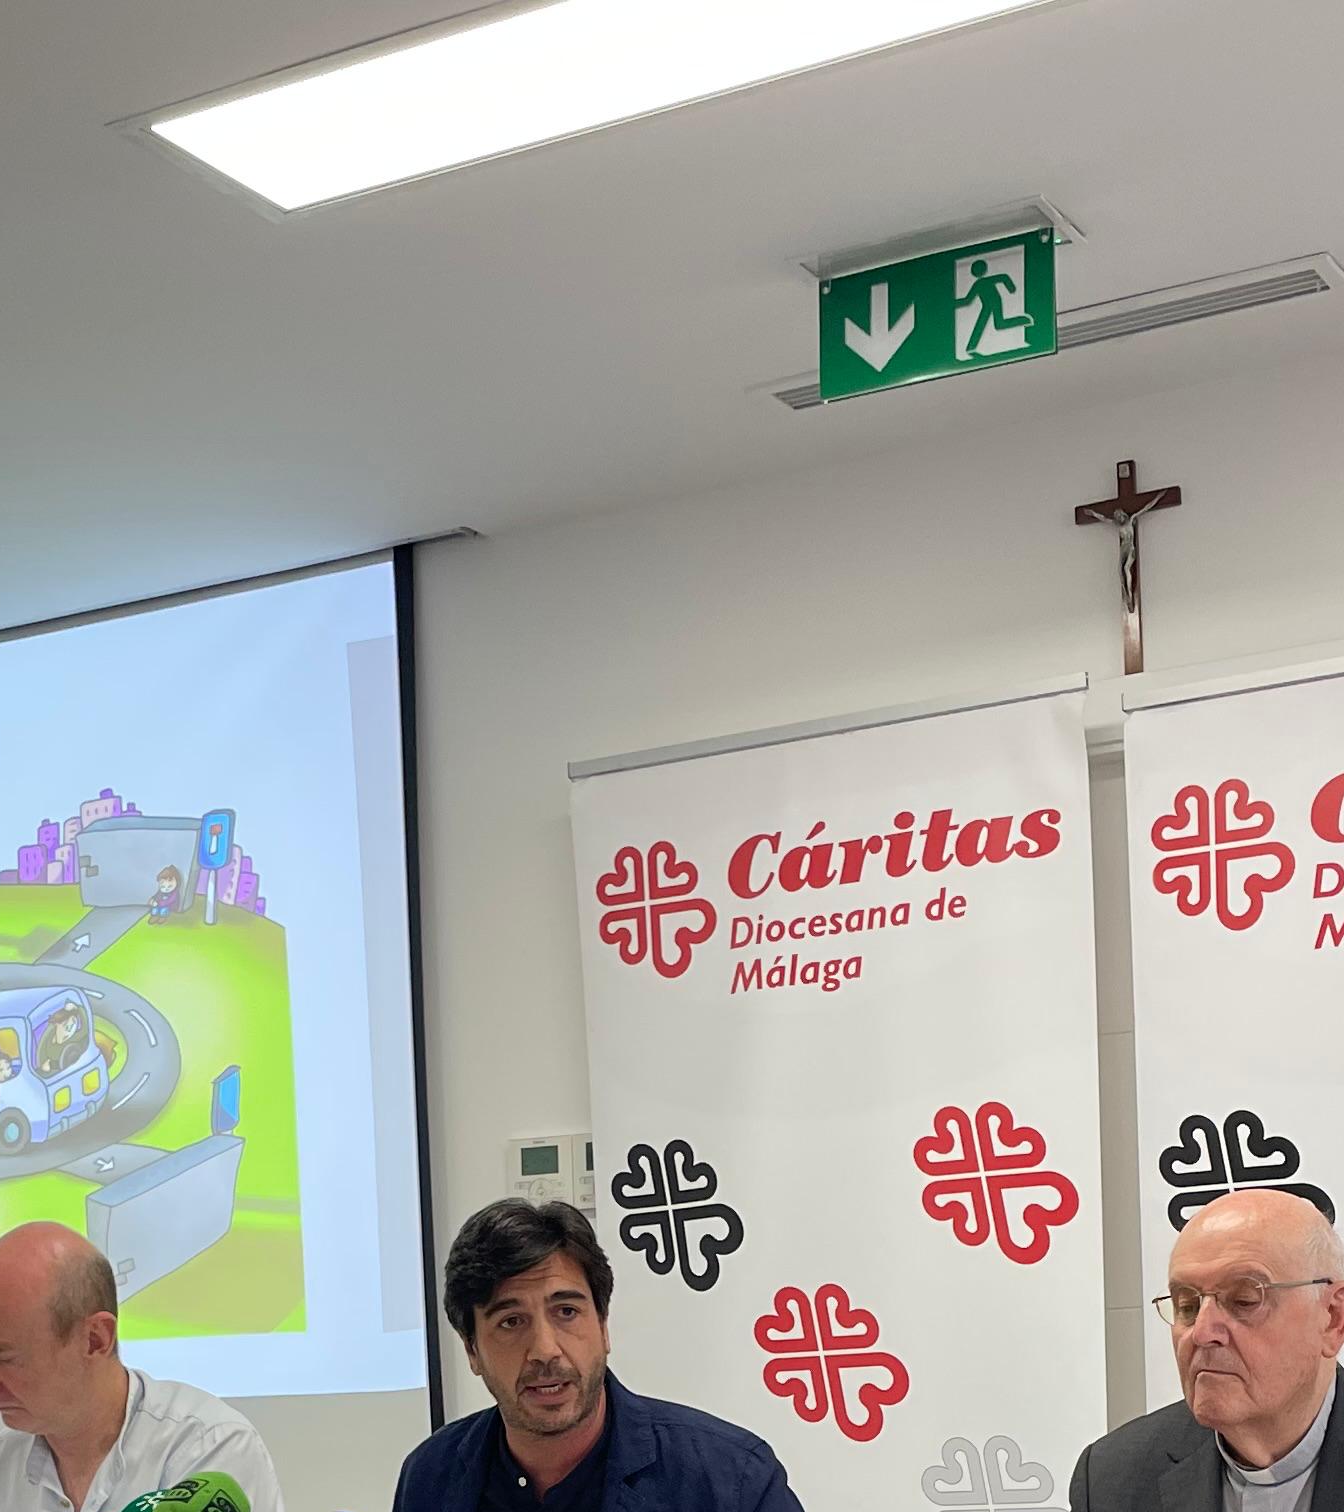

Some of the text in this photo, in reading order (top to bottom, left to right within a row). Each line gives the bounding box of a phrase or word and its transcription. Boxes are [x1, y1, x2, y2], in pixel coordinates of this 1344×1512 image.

[727, 807, 1062, 900] Cáritas
[729, 887, 967, 950] Diocesana de
[729, 954, 863, 995] Málaga
